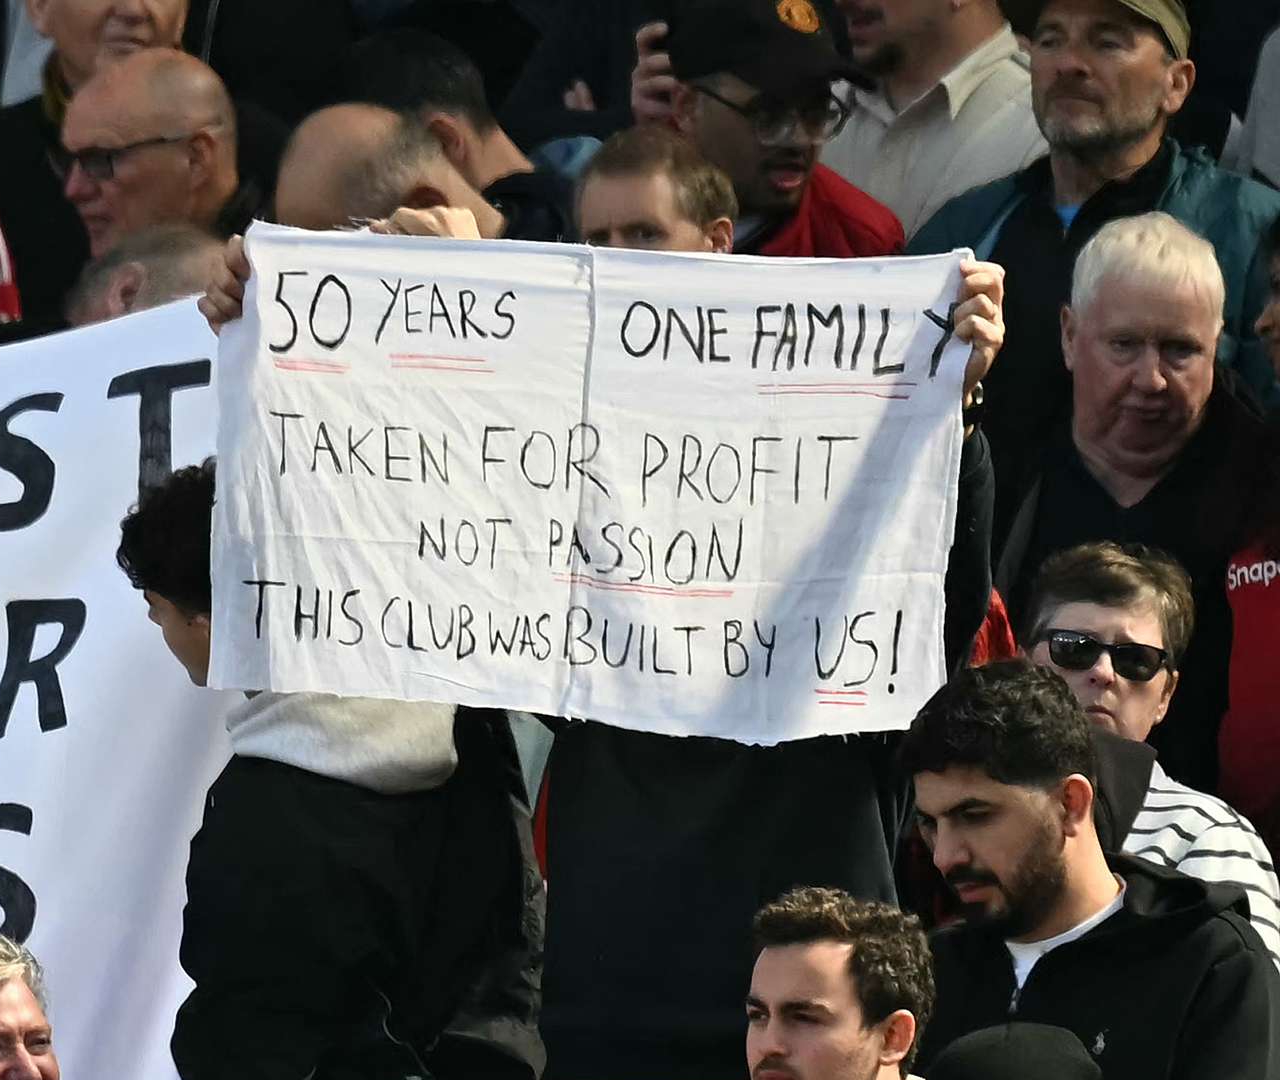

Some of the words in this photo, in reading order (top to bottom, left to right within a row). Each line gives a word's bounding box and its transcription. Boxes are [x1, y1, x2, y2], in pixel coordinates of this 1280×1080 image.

[268, 270, 353, 353] 50
[374, 277, 517, 346] YEARS
[620, 300, 731, 364] ONE
[751, 301, 958, 379] FAMILY
[268, 410, 450, 484] TAKEN
[481, 421, 611, 498] FOR
[642, 432, 860, 508] PROFIT
[418, 516, 512, 570] NOT
[548, 517, 744, 585] PASSION
[1226, 560, 1280, 591] Snap
[242, 579, 364, 646] THIS
[380, 595, 477, 661] CLUB
[487, 610, 553, 661] WAS
[563, 605, 706, 676] BUILT
[722, 618, 777, 679] BY
[814, 609, 904, 695] US!
